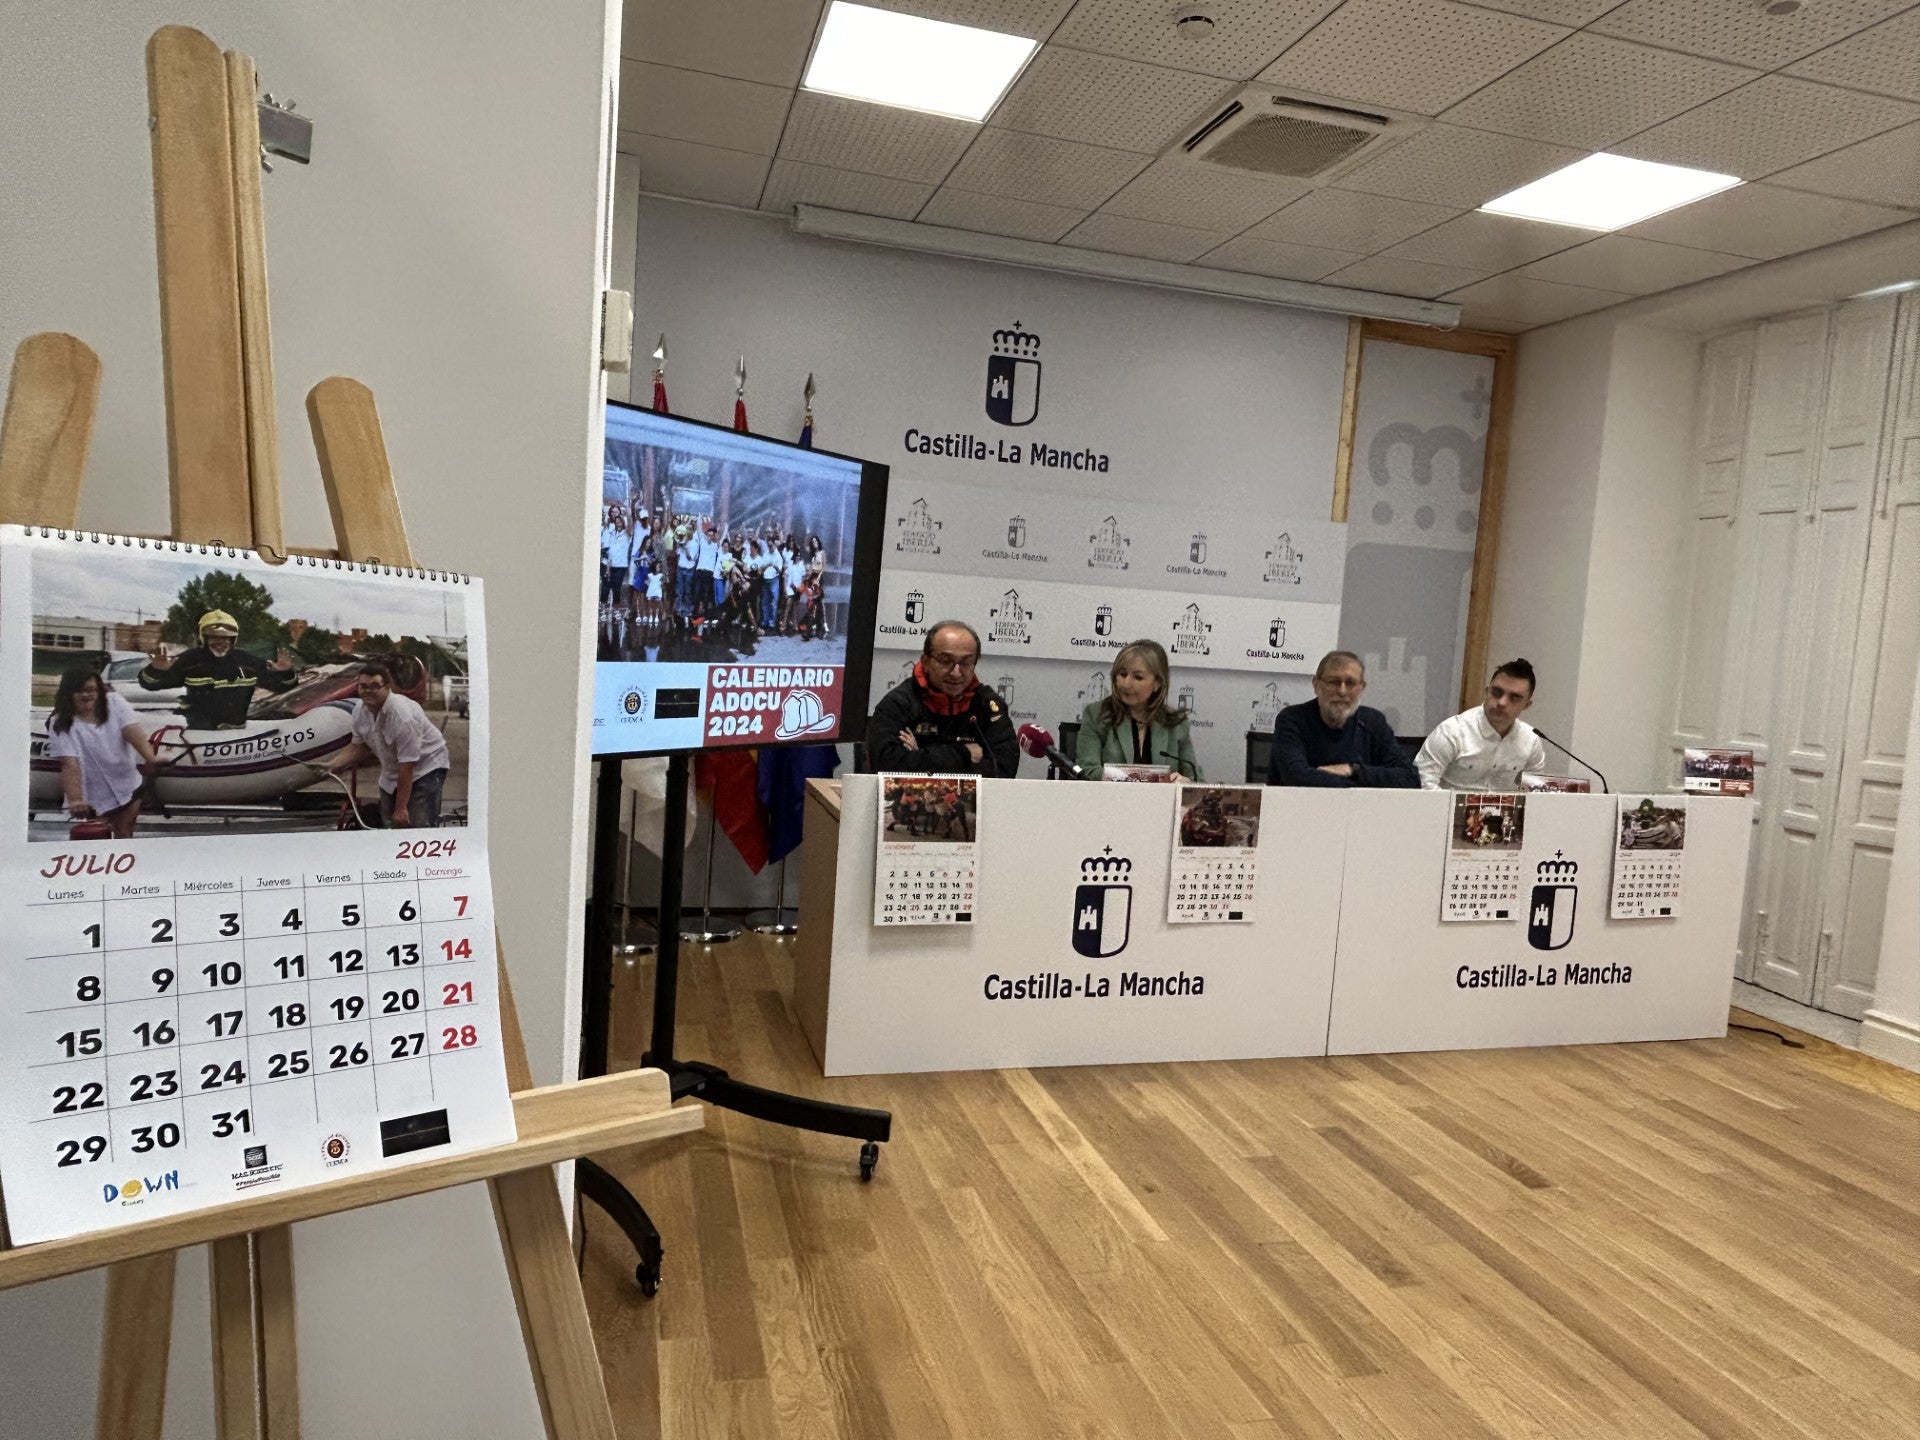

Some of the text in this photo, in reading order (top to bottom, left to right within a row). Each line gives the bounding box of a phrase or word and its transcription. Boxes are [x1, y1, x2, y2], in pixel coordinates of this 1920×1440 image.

[904, 428, 1110, 473] Castilla-La Mancha
[712, 668, 834, 688] CALENDARIO
[710, 691, 781, 712] ADOCU
[708, 714, 764, 736] 2024
[203, 728, 315, 758] Bomberos
[40, 838, 457, 879] JULIO 2024
[47, 890, 85, 900] Lunes
[121, 886, 160, 895] Martes
[184, 881, 234, 891] Miércoles
[256, 877, 292, 887] Jueves
[316, 874, 351, 884] Viernes
[83, 896, 468, 949] 1 2 3 4 5 6 7
[76, 938, 472, 1002] 8 9 10 11 12 13 14
[984, 971, 1204, 1000] Castilla-La Mancha
[1456, 962, 1632, 988] Castilla-La Mancha
[56, 982, 474, 1058] 15 16 17 18 19 20 21
[52, 1025, 478, 1114] 22 23 24 25 26 27 28
[56, 1109, 251, 1168] 29 30 31
[103, 1170, 179, 1203] DOWN
